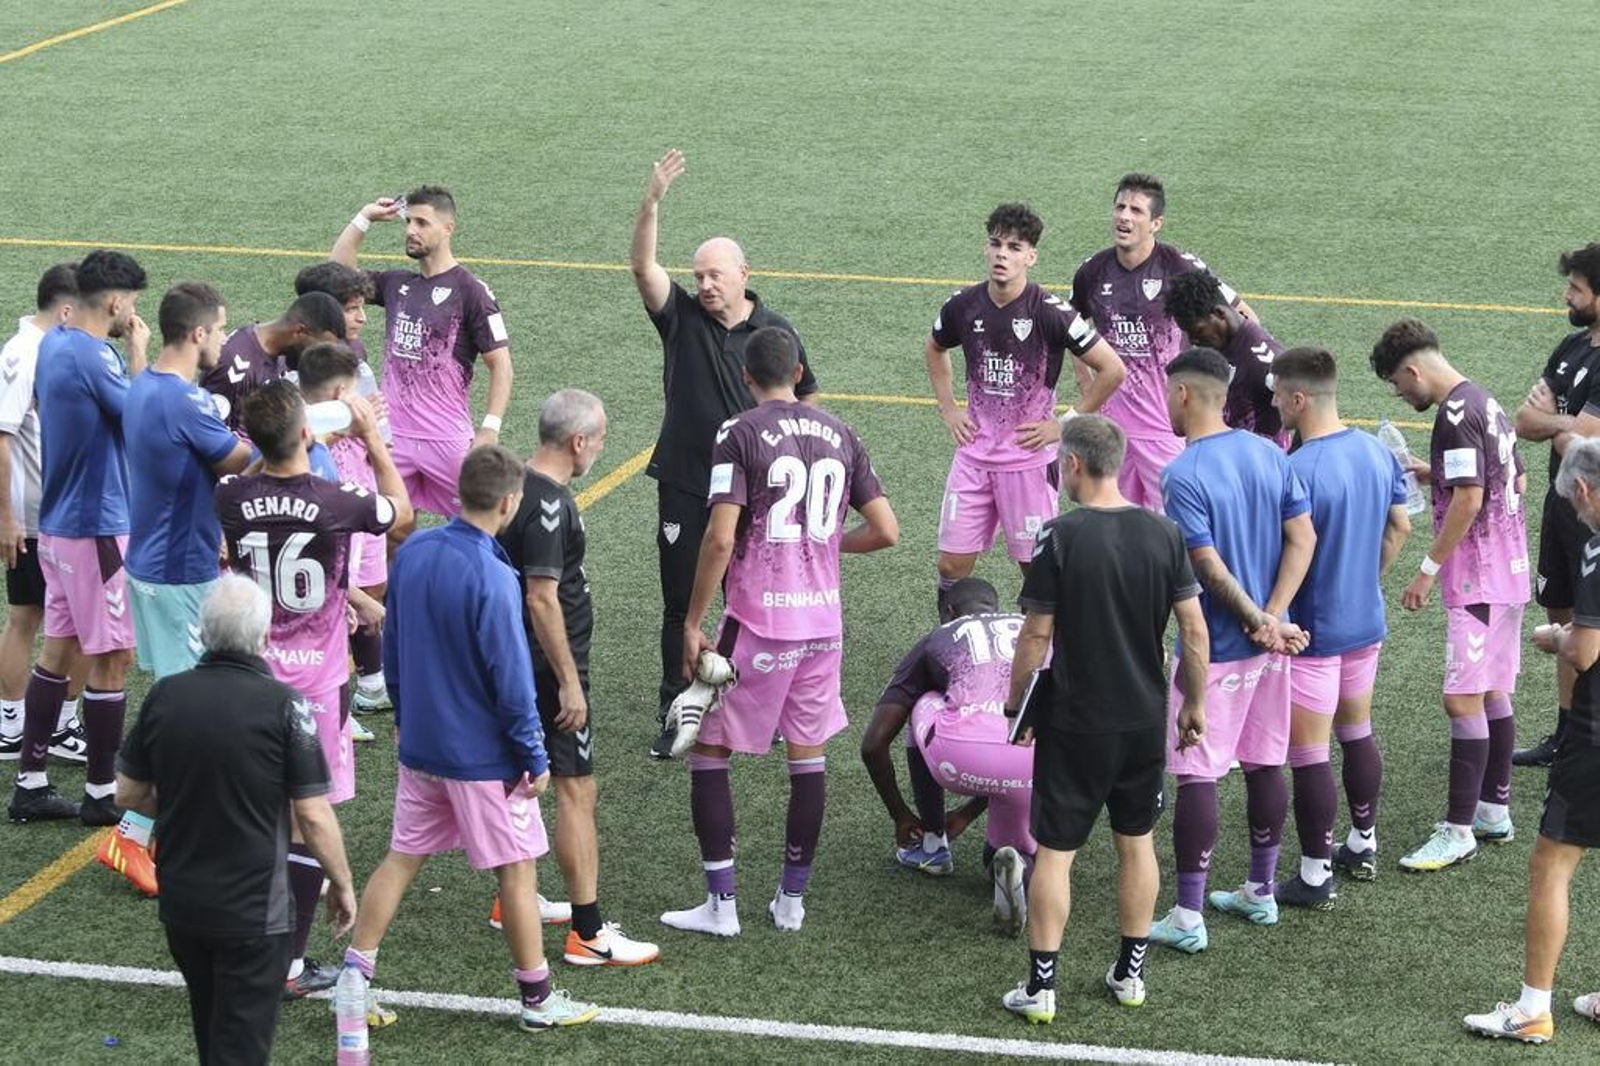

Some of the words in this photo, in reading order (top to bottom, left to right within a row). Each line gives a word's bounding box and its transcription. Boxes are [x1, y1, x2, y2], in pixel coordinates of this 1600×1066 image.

[241, 496, 320, 523] GENARO
[766, 455, 846, 543] 20
[237, 531, 326, 614] 16
[952, 618, 1025, 665] 18
[960, 772, 999, 787] COSTA
[1002, 779, 1025, 788] DEL
